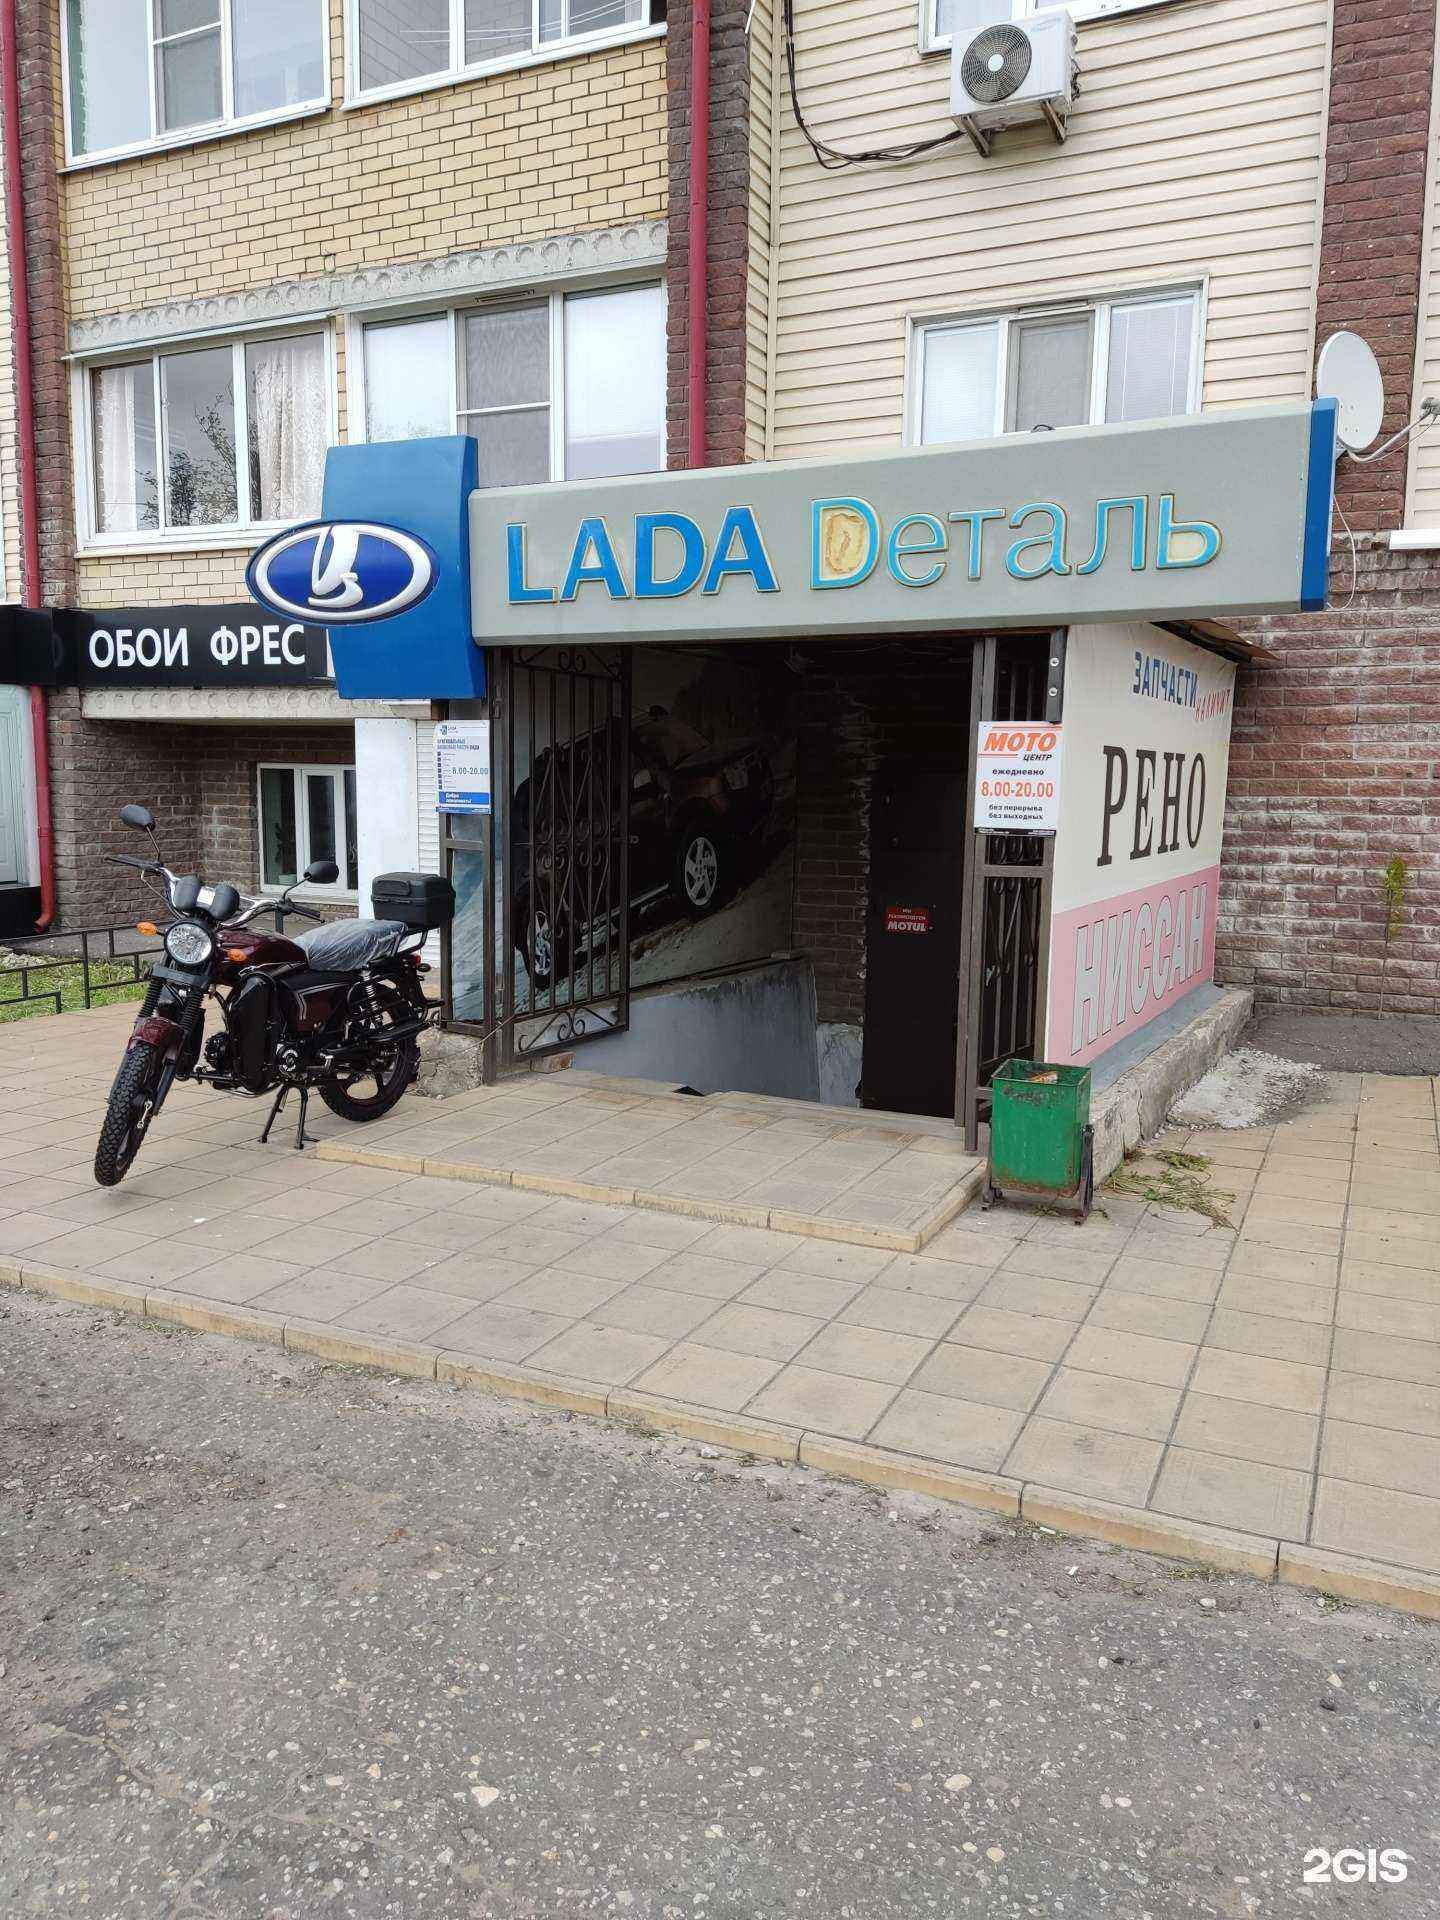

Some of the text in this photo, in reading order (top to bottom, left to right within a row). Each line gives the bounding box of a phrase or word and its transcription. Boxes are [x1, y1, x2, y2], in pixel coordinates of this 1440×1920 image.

[506, 505, 780, 604] LADA
[88, 627, 189, 668] ОБОИ
[1132, 650, 1198, 709] ЗАПЧАСТИ
[983, 732, 1057, 752] МОТО
[992, 768, 1045, 776] ежедневно
[1023, 753, 1053, 762] ЦЕНТР
[988, 804, 1003, 812] без
[1096, 745, 1206, 867] РЕНО
[887, 921, 927, 932] MOTUL
[1071, 881, 1208, 1056] НИССАН
